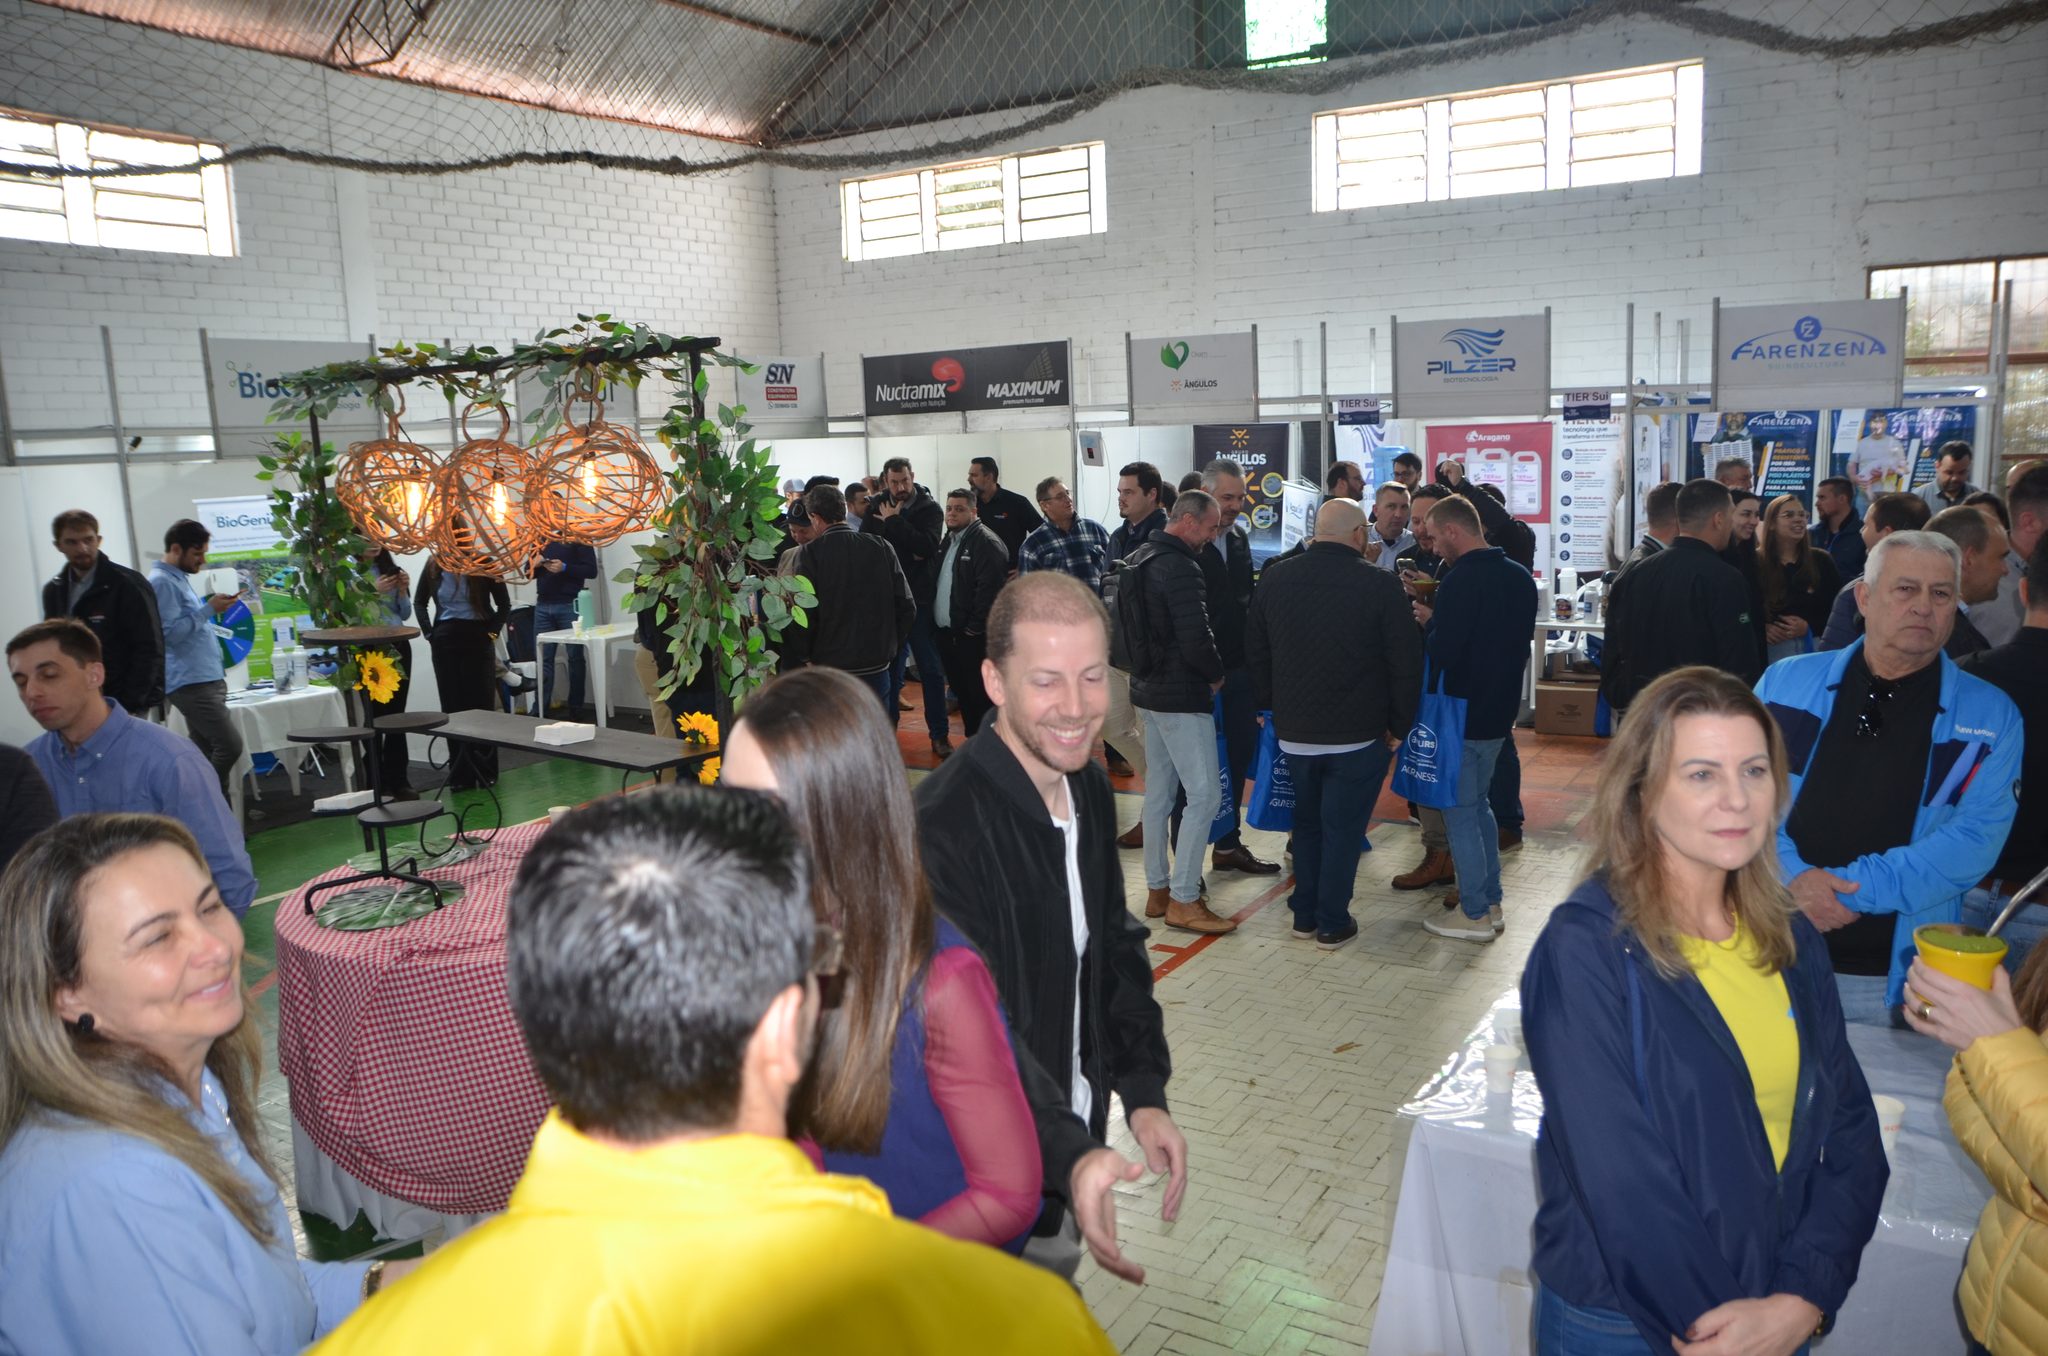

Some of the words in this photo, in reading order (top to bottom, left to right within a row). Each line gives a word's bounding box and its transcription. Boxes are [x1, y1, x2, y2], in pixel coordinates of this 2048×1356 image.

[1731, 341, 1887, 360] FARENZENA
[765, 363, 795, 384] SN
[1427, 358, 1516, 375] PILZER
[986, 380, 1062, 398] MAXIMUM
[1184, 379, 1218, 389] ÂNGULOS
[1339, 399, 1361, 408] TIER
[1363, 398, 1378, 408] Sui
[1565, 393, 1590, 402] TIER
[1592, 391, 1609, 401] Sui
[1748, 417, 1812, 426] FARENZENA
